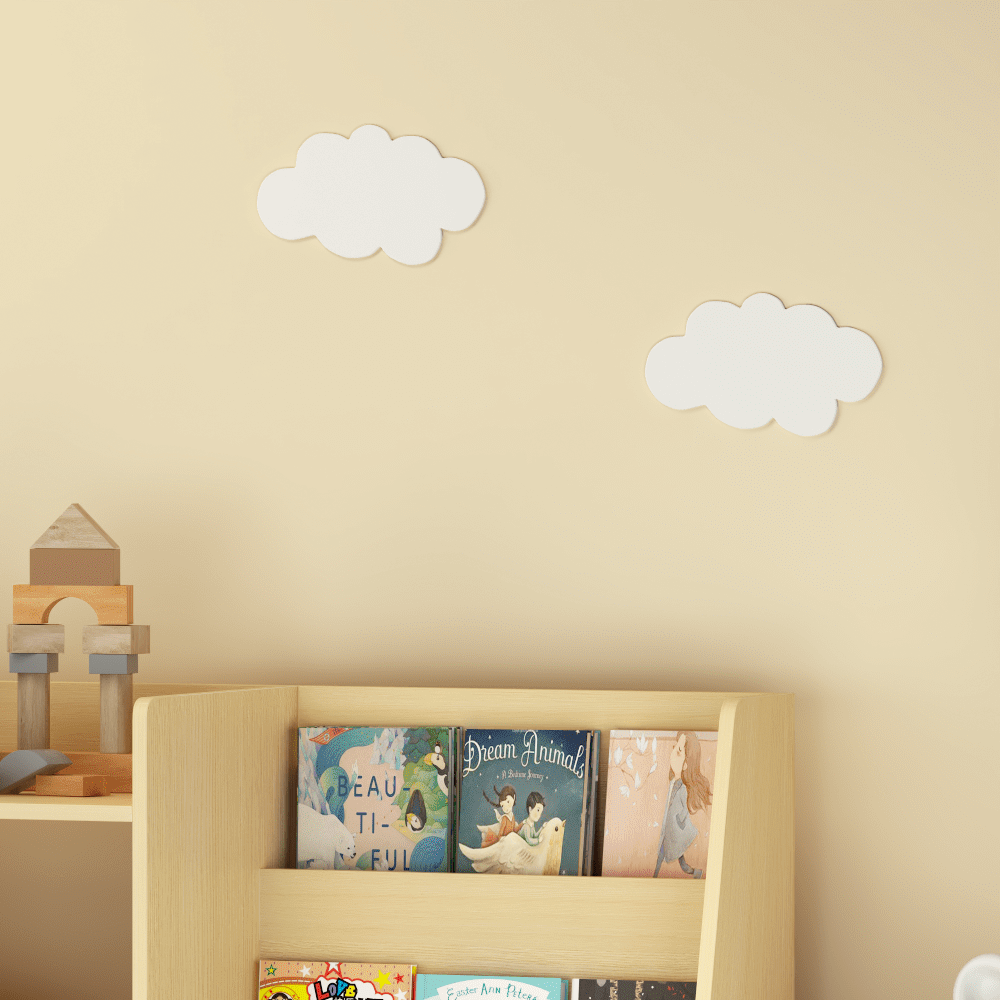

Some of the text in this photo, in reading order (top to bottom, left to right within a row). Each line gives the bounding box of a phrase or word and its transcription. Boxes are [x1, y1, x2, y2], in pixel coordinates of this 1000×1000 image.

[463, 730, 585, 779] Dream Animals
[371, 849, 410, 871] FUL
